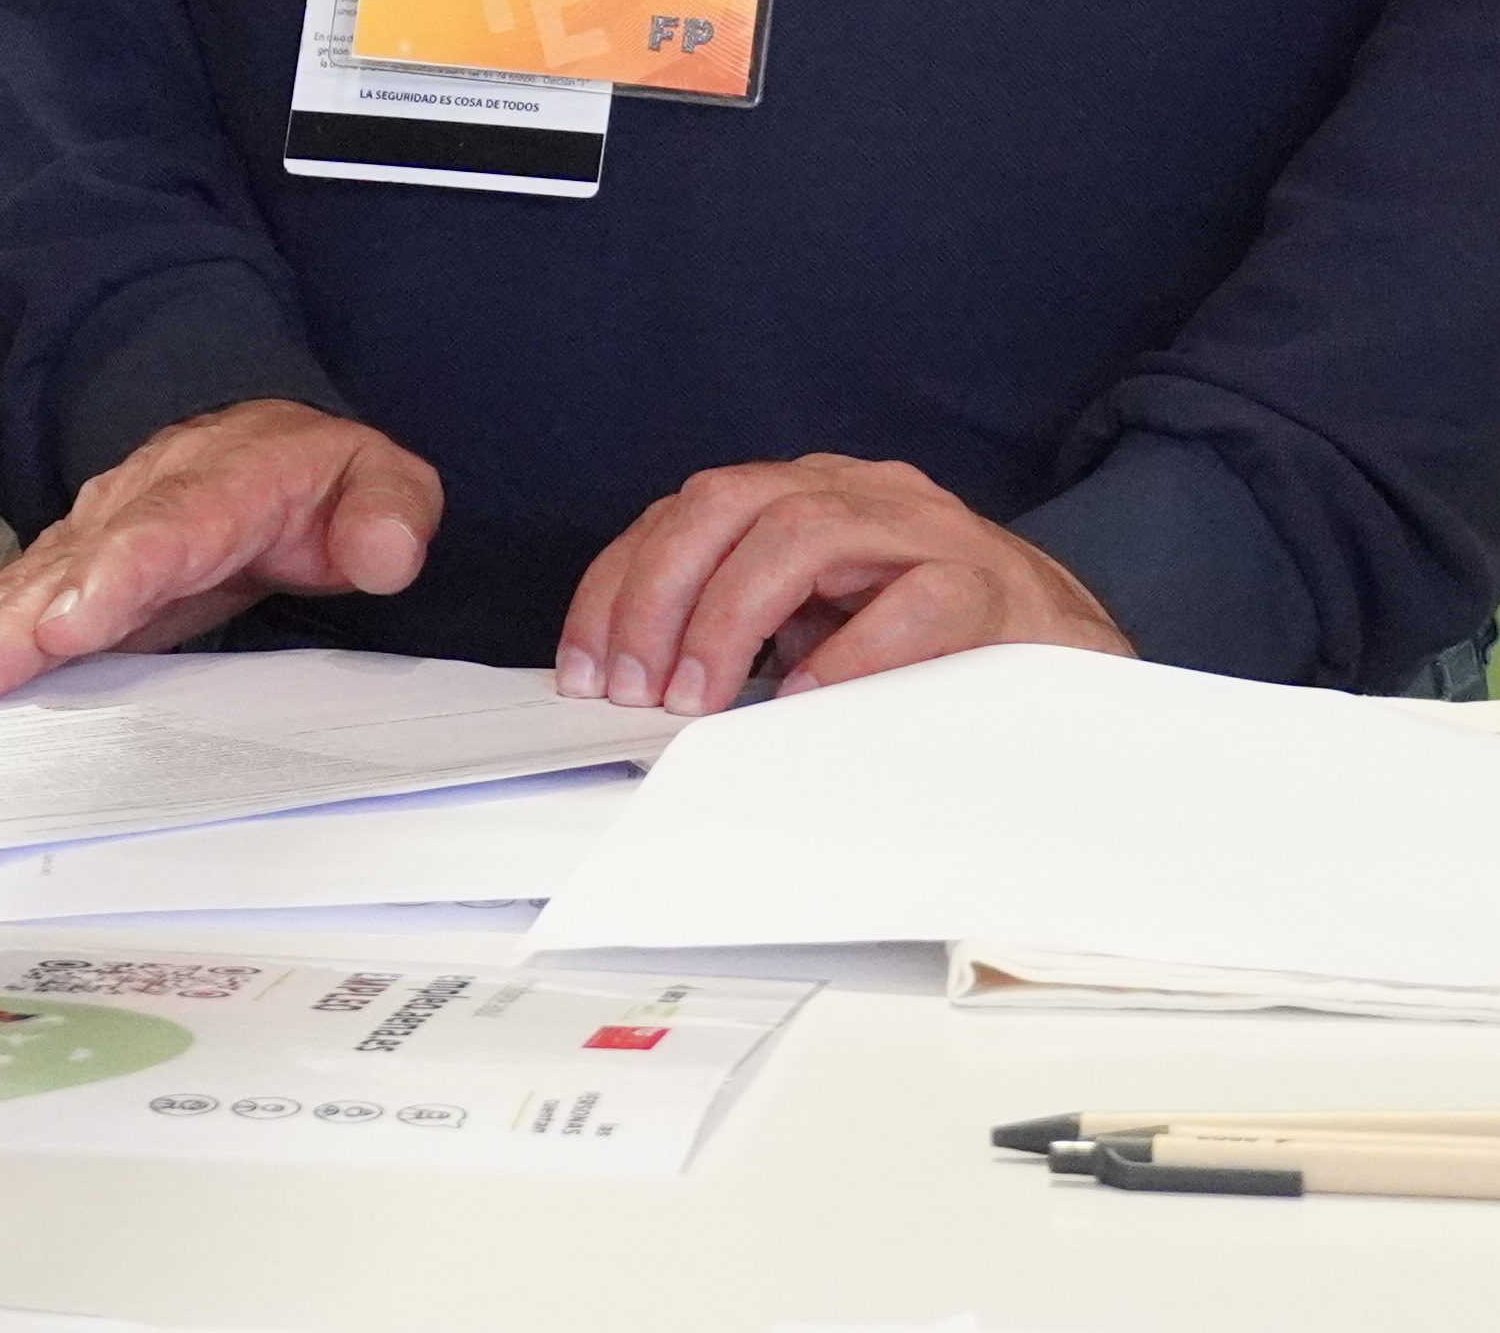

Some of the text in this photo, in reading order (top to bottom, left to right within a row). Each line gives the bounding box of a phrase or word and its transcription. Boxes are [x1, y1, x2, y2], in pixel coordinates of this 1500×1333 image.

[648, 14, 715, 54] FP
[360, 89, 540, 112] LA SEGURIDAD ES COSA DE TODOS
